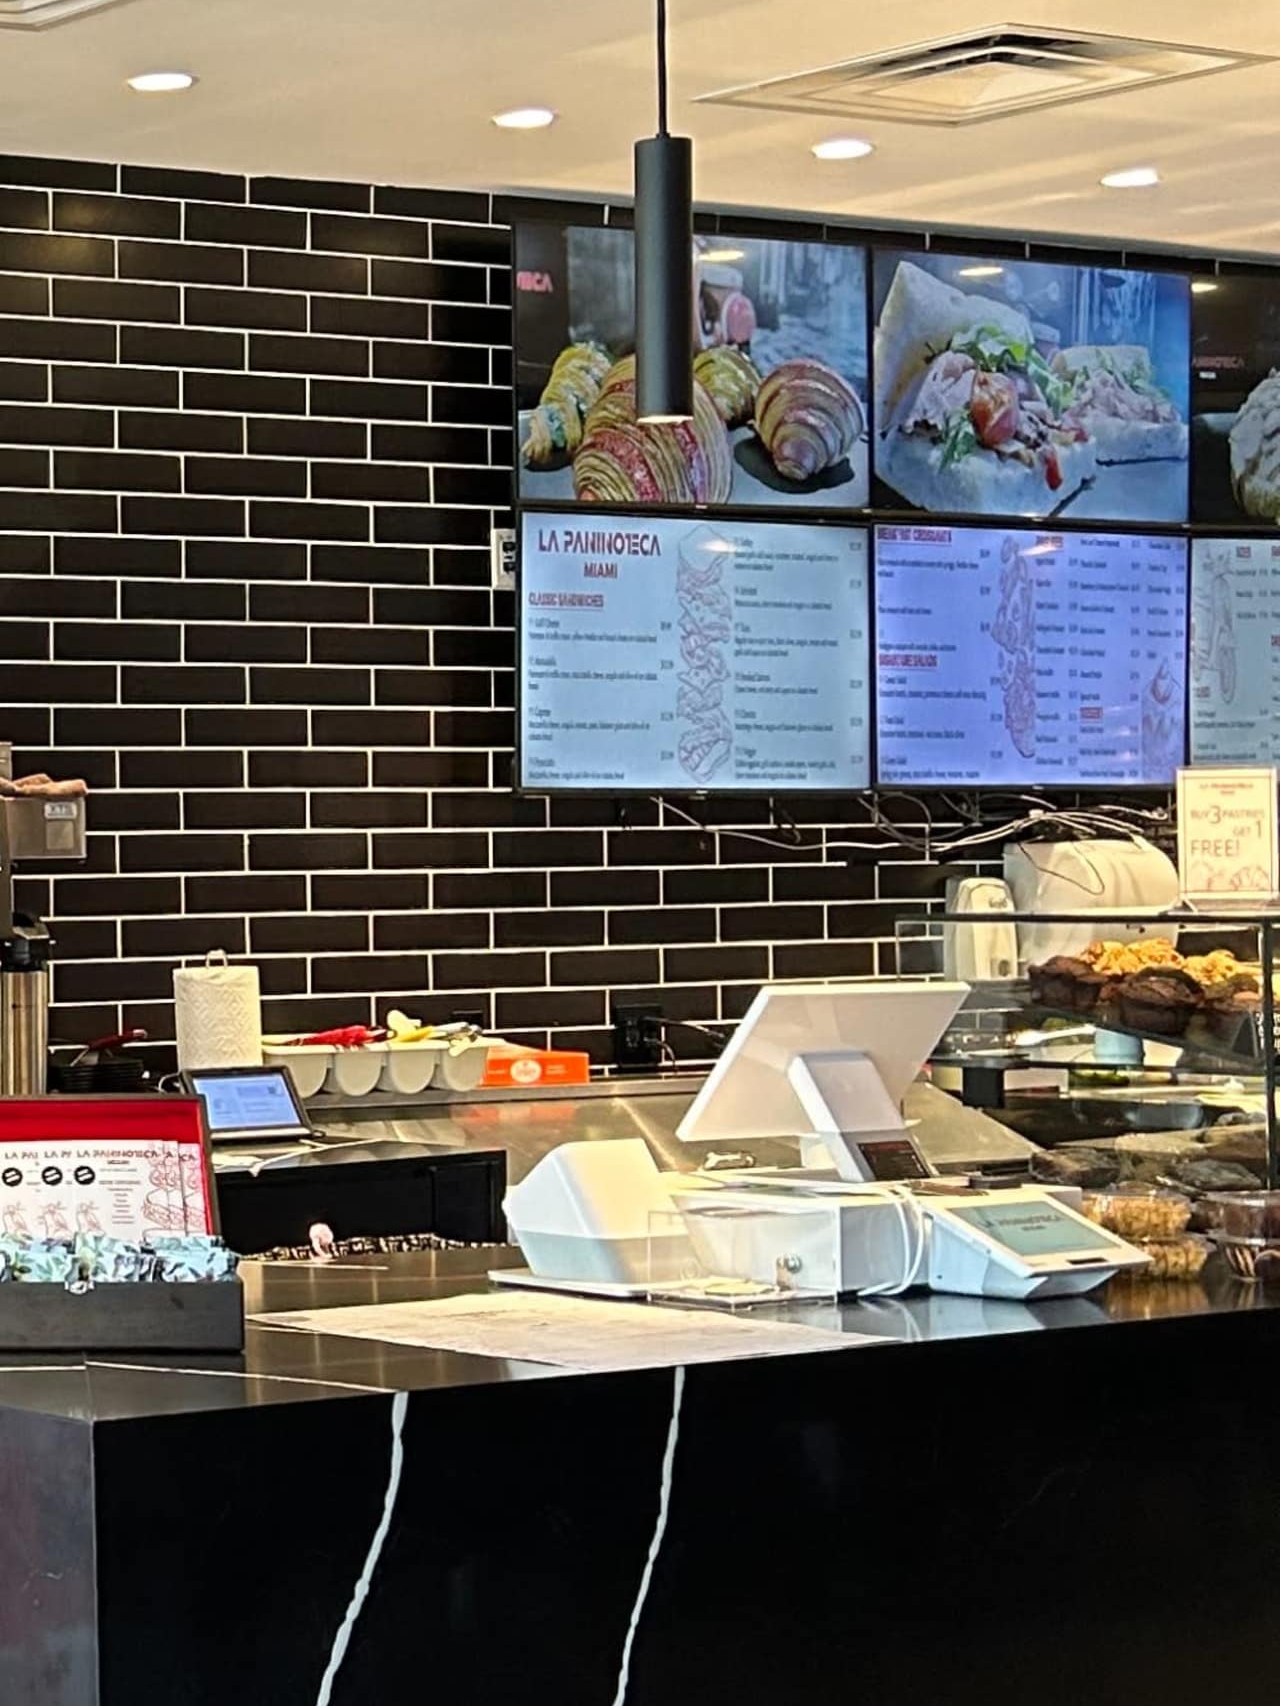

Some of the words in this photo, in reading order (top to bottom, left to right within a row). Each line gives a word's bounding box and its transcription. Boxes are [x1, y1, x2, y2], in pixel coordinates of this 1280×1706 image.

[538, 529, 560, 553] LA
[563, 531, 662, 557] PANINOTECA
[583, 562, 618, 579] MIAMI
[1209, 804, 1222, 825] 3
[1256, 819, 1263, 840] 1
[1190, 838, 1241, 858] FREE!
